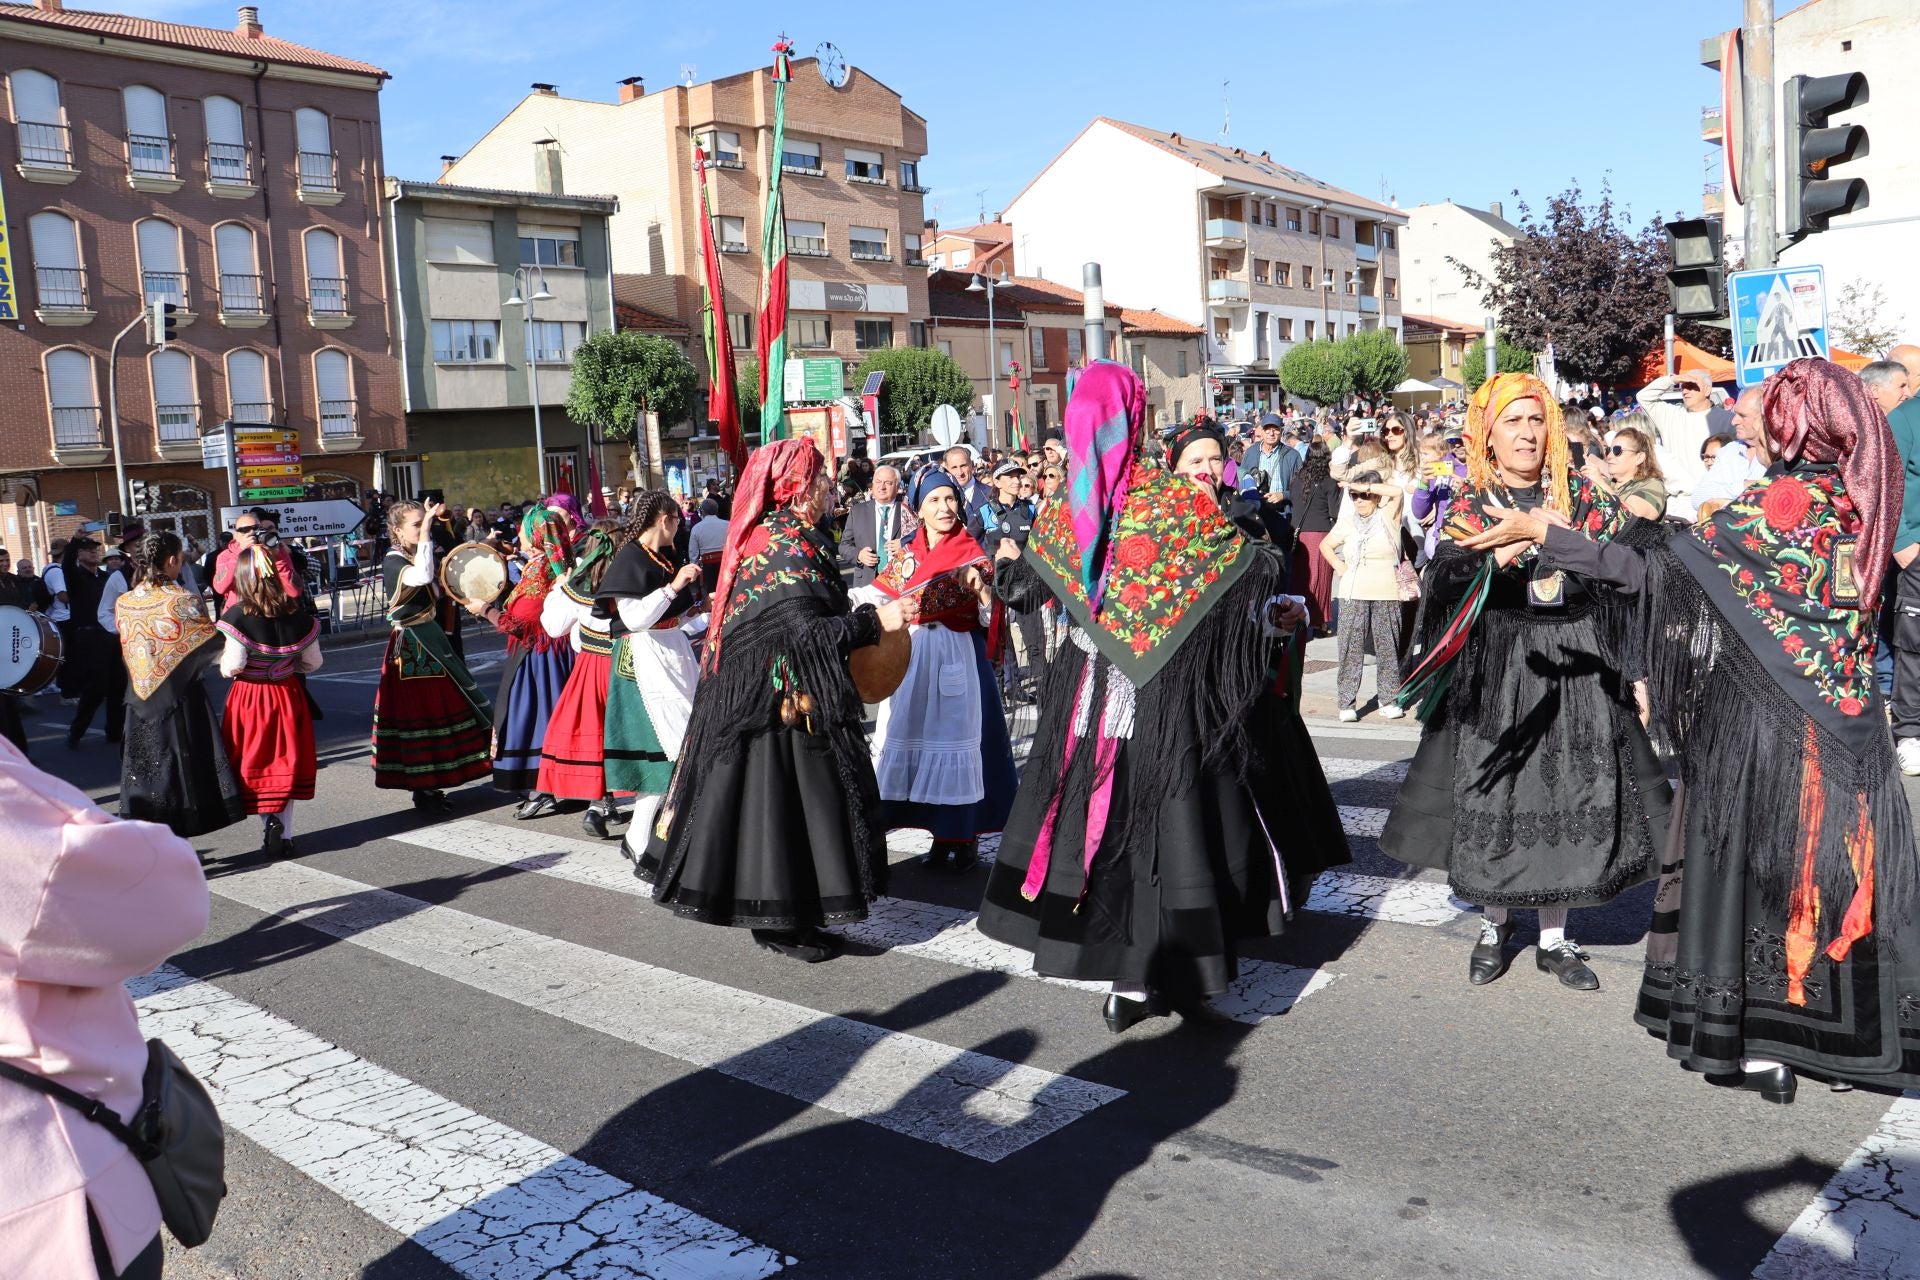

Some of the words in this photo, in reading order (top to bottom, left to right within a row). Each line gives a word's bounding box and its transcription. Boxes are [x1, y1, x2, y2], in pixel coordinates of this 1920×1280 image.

[258, 489, 284, 497] ASPRONA
[285, 515, 318, 524] Señora
[293, 524, 308, 532] del
[312, 522, 346, 531] Camino
